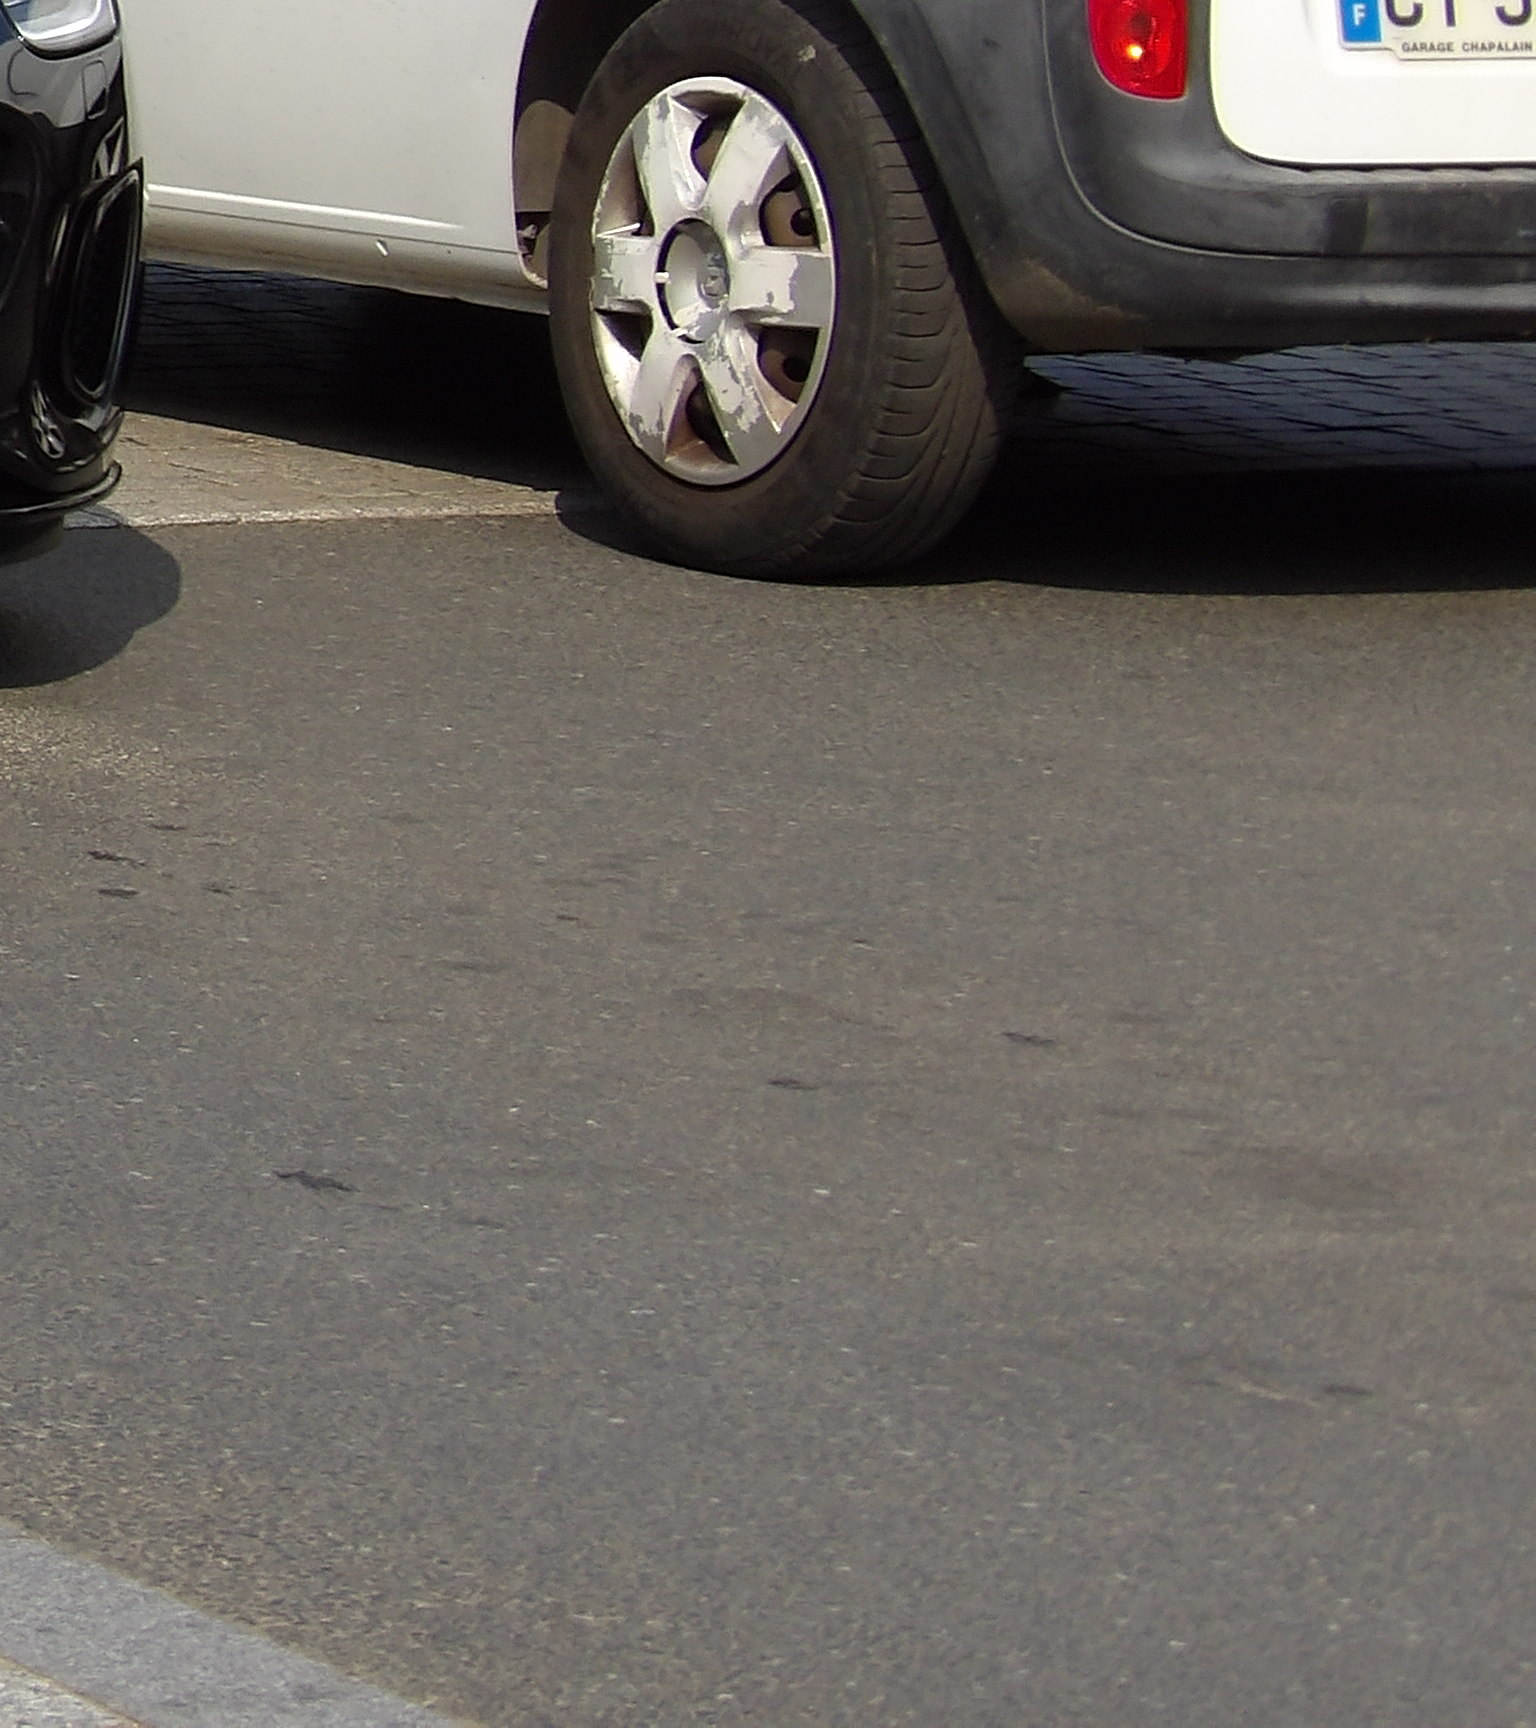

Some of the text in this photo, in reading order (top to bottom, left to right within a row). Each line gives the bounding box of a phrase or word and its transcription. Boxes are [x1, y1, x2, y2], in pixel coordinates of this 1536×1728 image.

[1352, 3, 1366, 26] F
[1401, 41, 1533, 53] GARAGE CHAPALAIN
